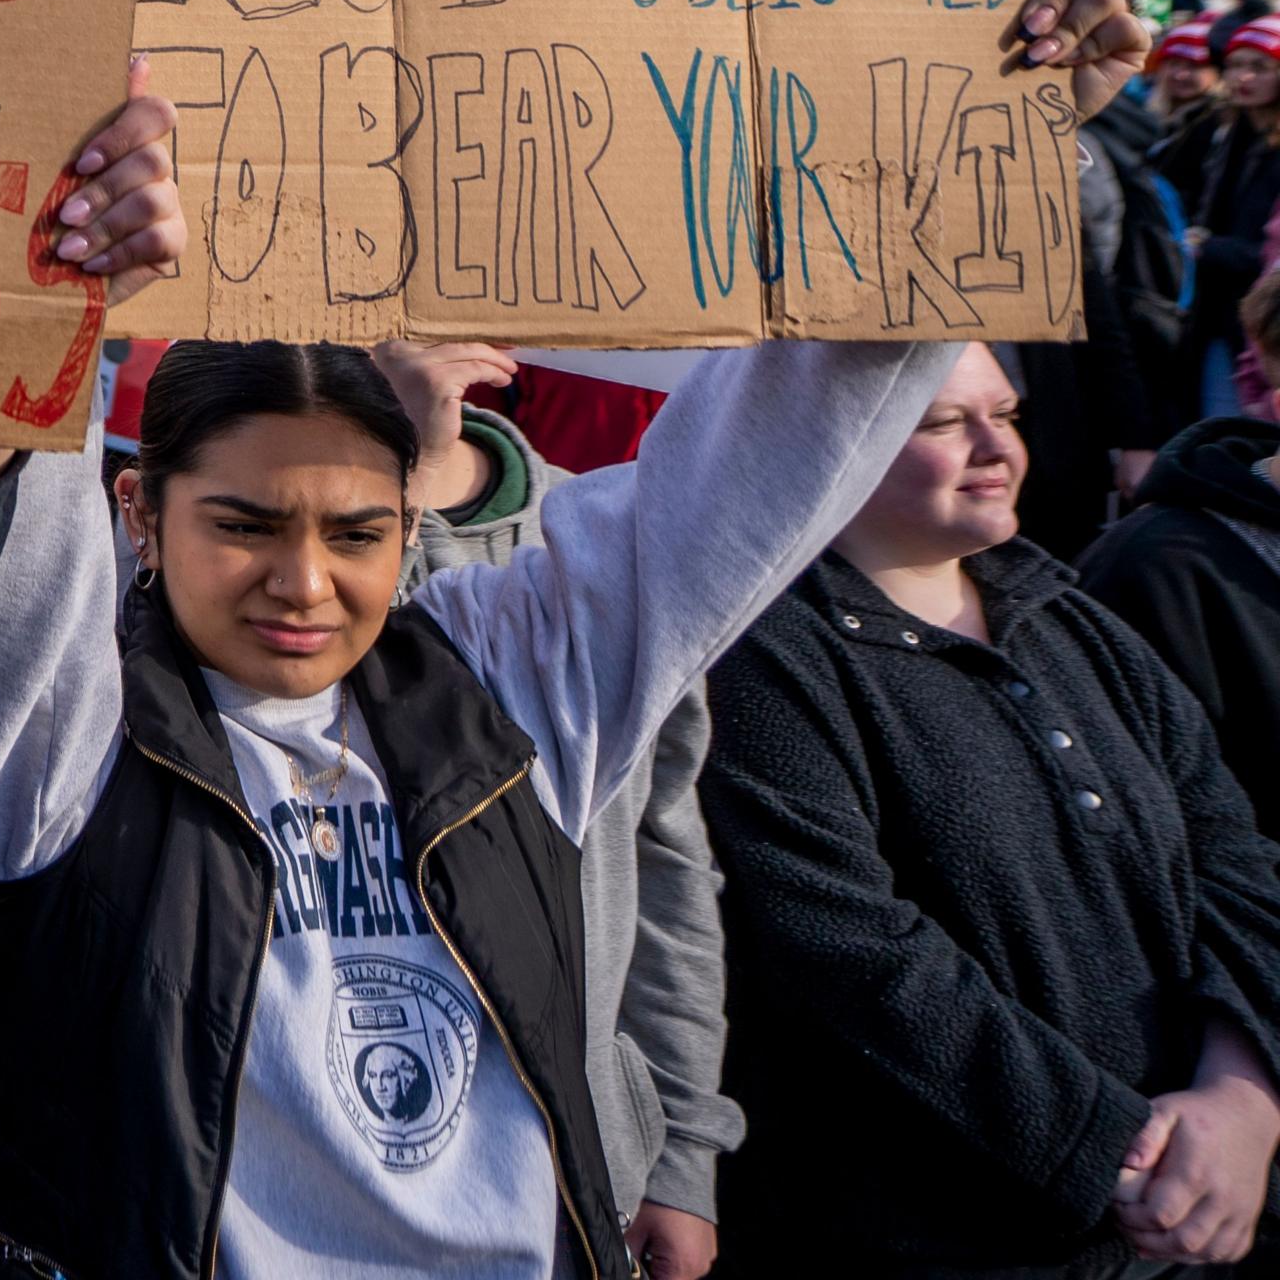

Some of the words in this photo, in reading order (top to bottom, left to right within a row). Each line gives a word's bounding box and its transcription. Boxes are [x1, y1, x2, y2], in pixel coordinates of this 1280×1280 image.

[318, 42, 647, 311] BEAR
[640, 47, 863, 311] YOUR
[868, 57, 1078, 329] KIDS
[351, 986, 388, 997] NOBIS
[384, 1145, 431, 1162] 1821
